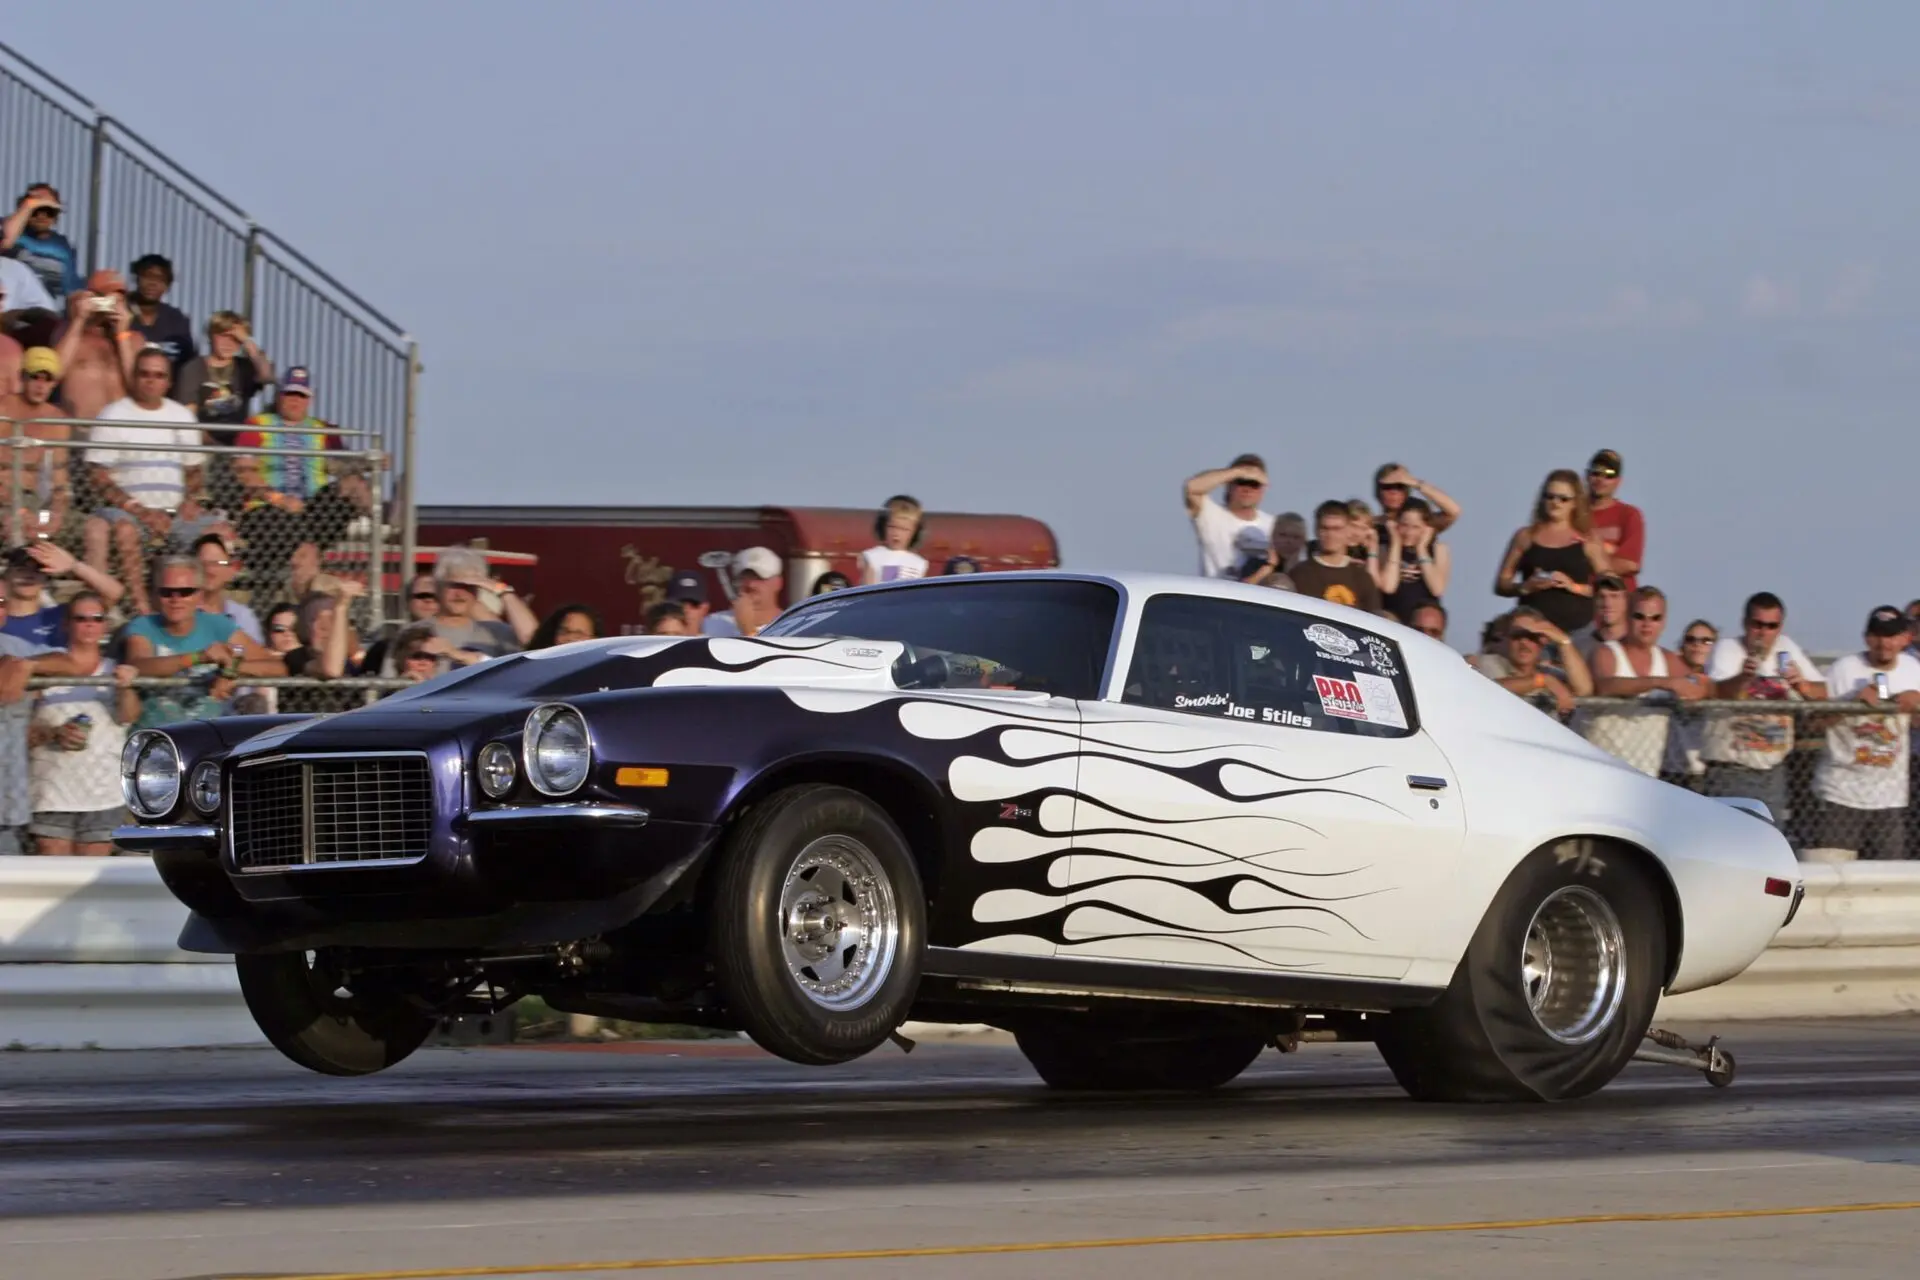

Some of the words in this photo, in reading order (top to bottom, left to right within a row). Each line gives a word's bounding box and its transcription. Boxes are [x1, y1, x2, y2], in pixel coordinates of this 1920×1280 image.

[1174, 693, 1230, 708] Smokin'
[1314, 677, 1363, 705] PRO
[1224, 702, 1256, 719] Joe
[1262, 707, 1313, 728] Stiles
